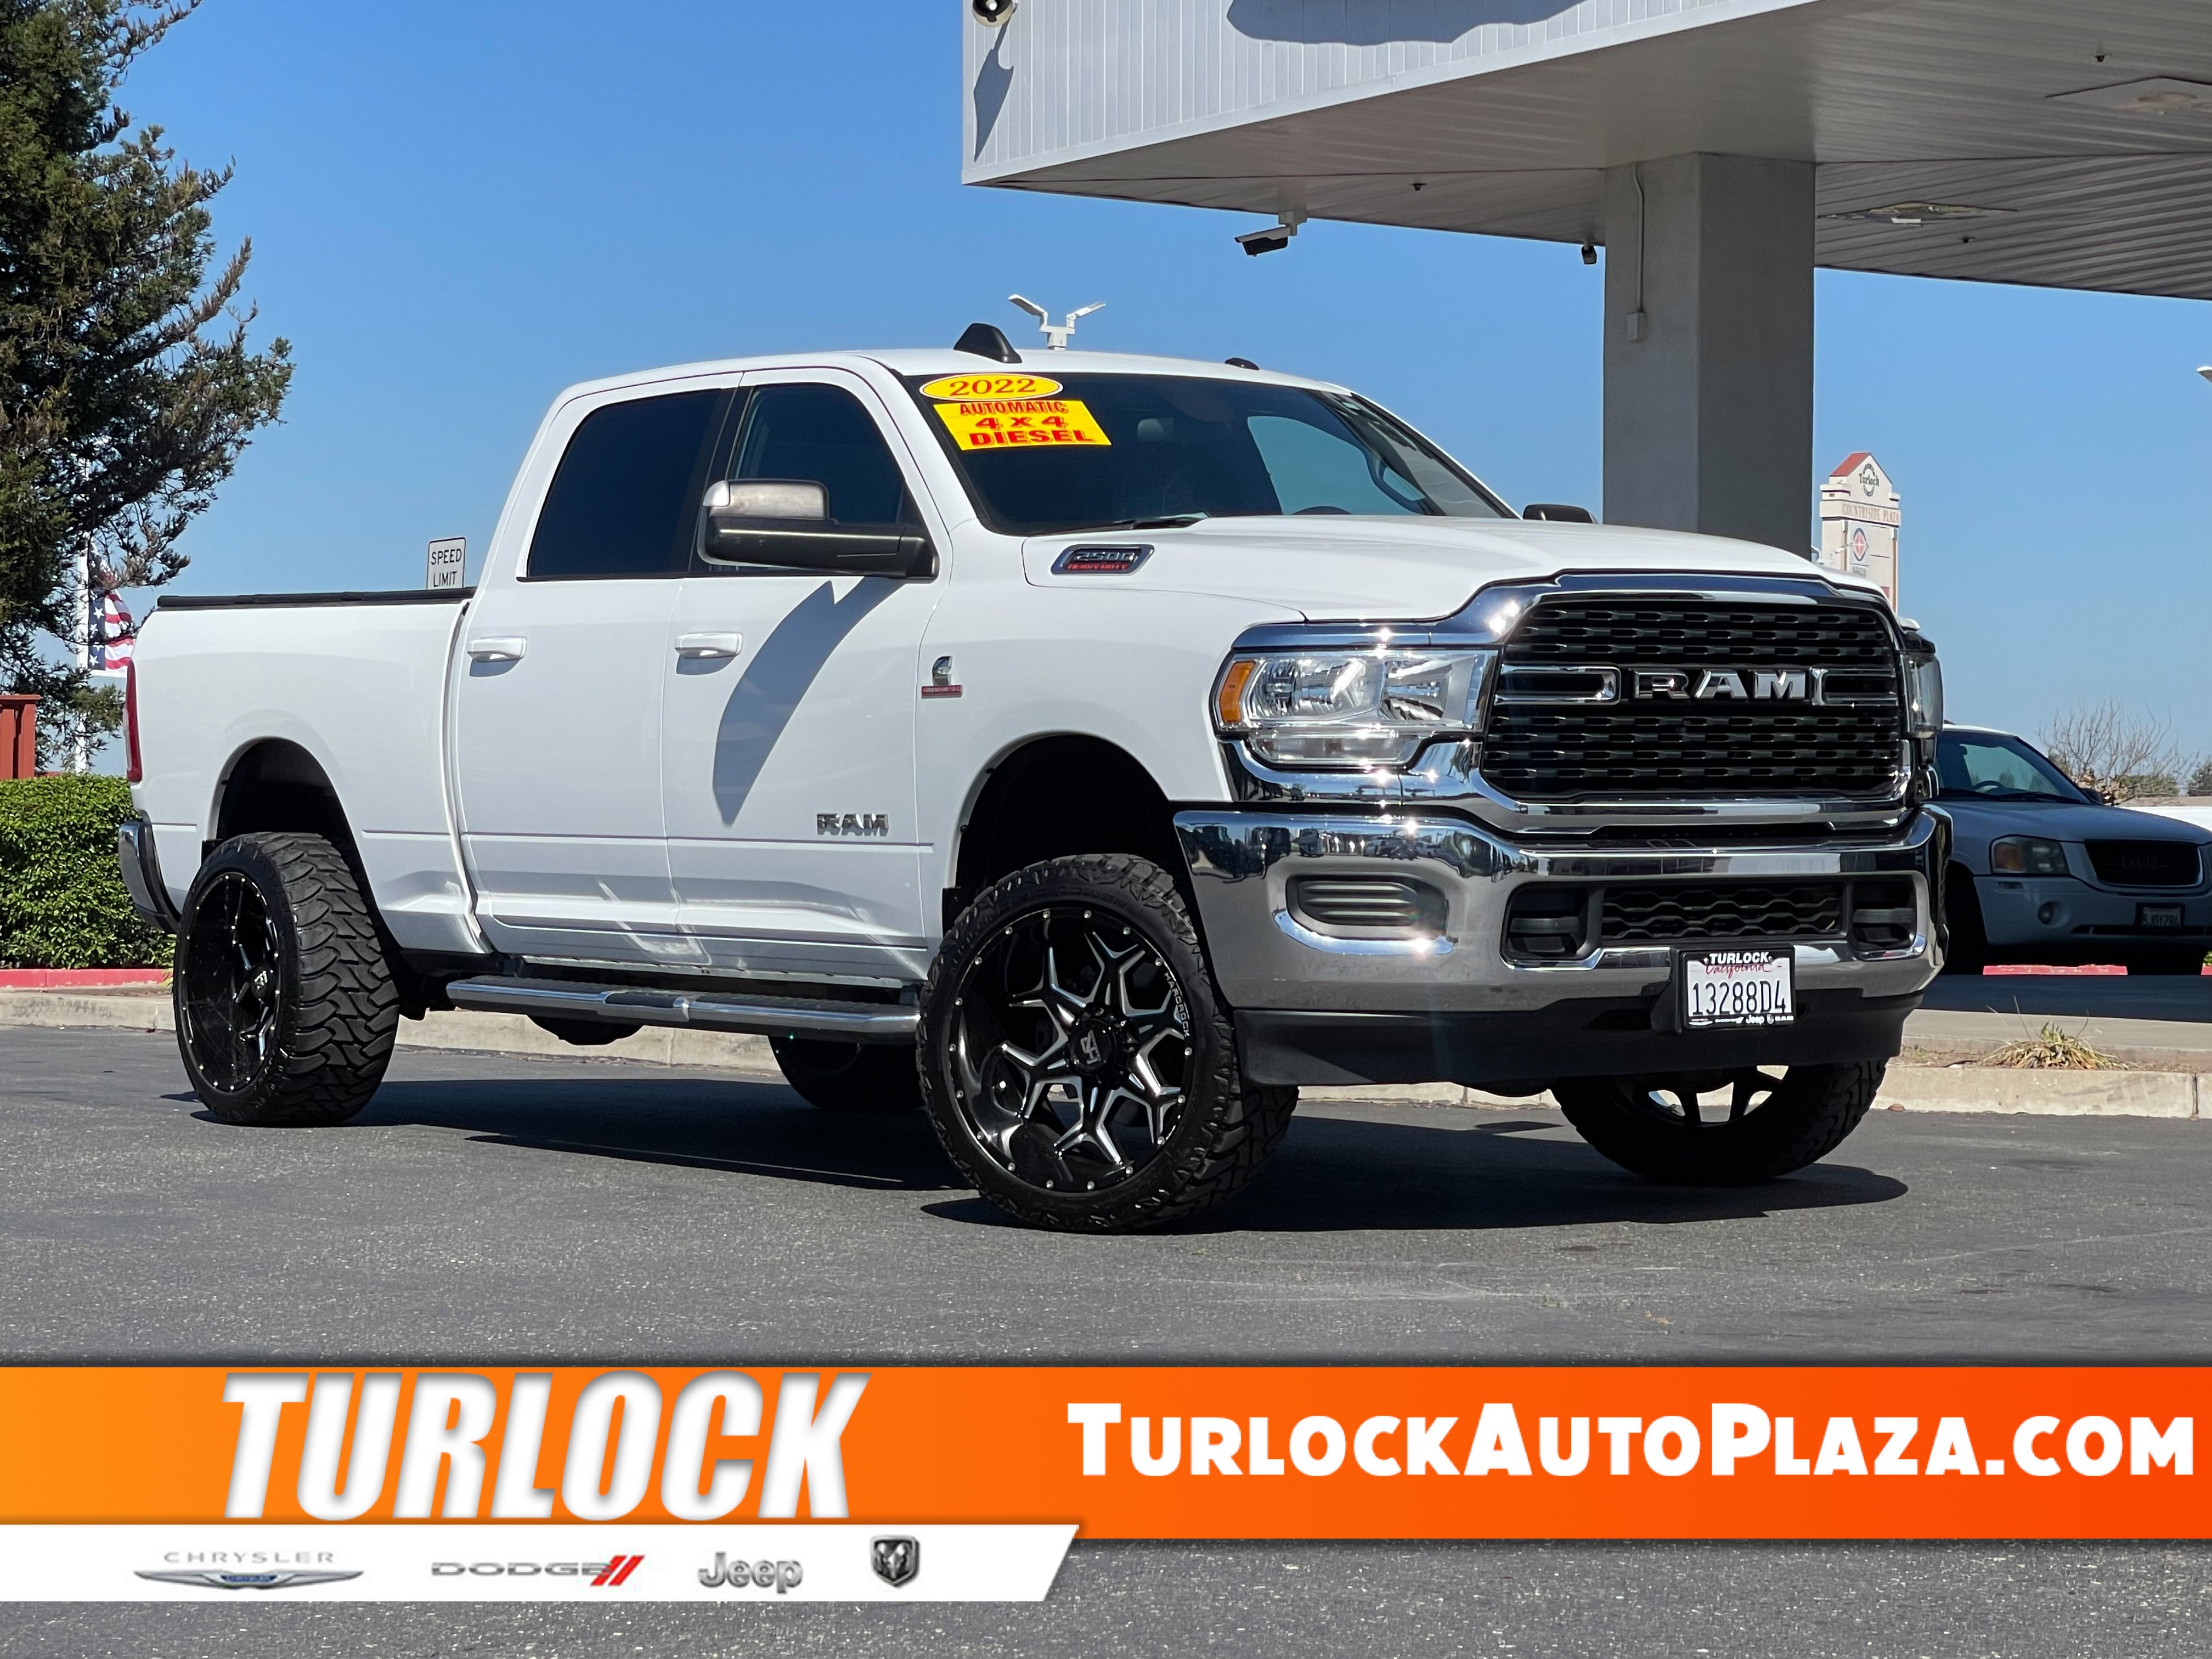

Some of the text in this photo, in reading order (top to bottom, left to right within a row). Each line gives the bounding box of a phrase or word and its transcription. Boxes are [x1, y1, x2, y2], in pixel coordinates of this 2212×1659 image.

[950, 378, 1036, 397] 2022
[960, 400, 1069, 416] AUTOMATIC
[969, 430, 1097, 447] DIESEL
[1843, 503, 1899, 523] COUNTRYSIDE PLAZA
[431, 548, 462, 565] SPEED
[1075, 551, 1131, 561] 2500
[433, 571, 458, 588] LIMIT
[1629, 668, 1807, 699] RAM
[816, 812, 889, 837] RAM
[1709, 952, 1769, 964] TURLOCK
[1164, 972, 1190, 1038] HARDROCK
[1692, 980, 1786, 1015] 13288D4
[1746, 1014, 1765, 1024] Jeep
